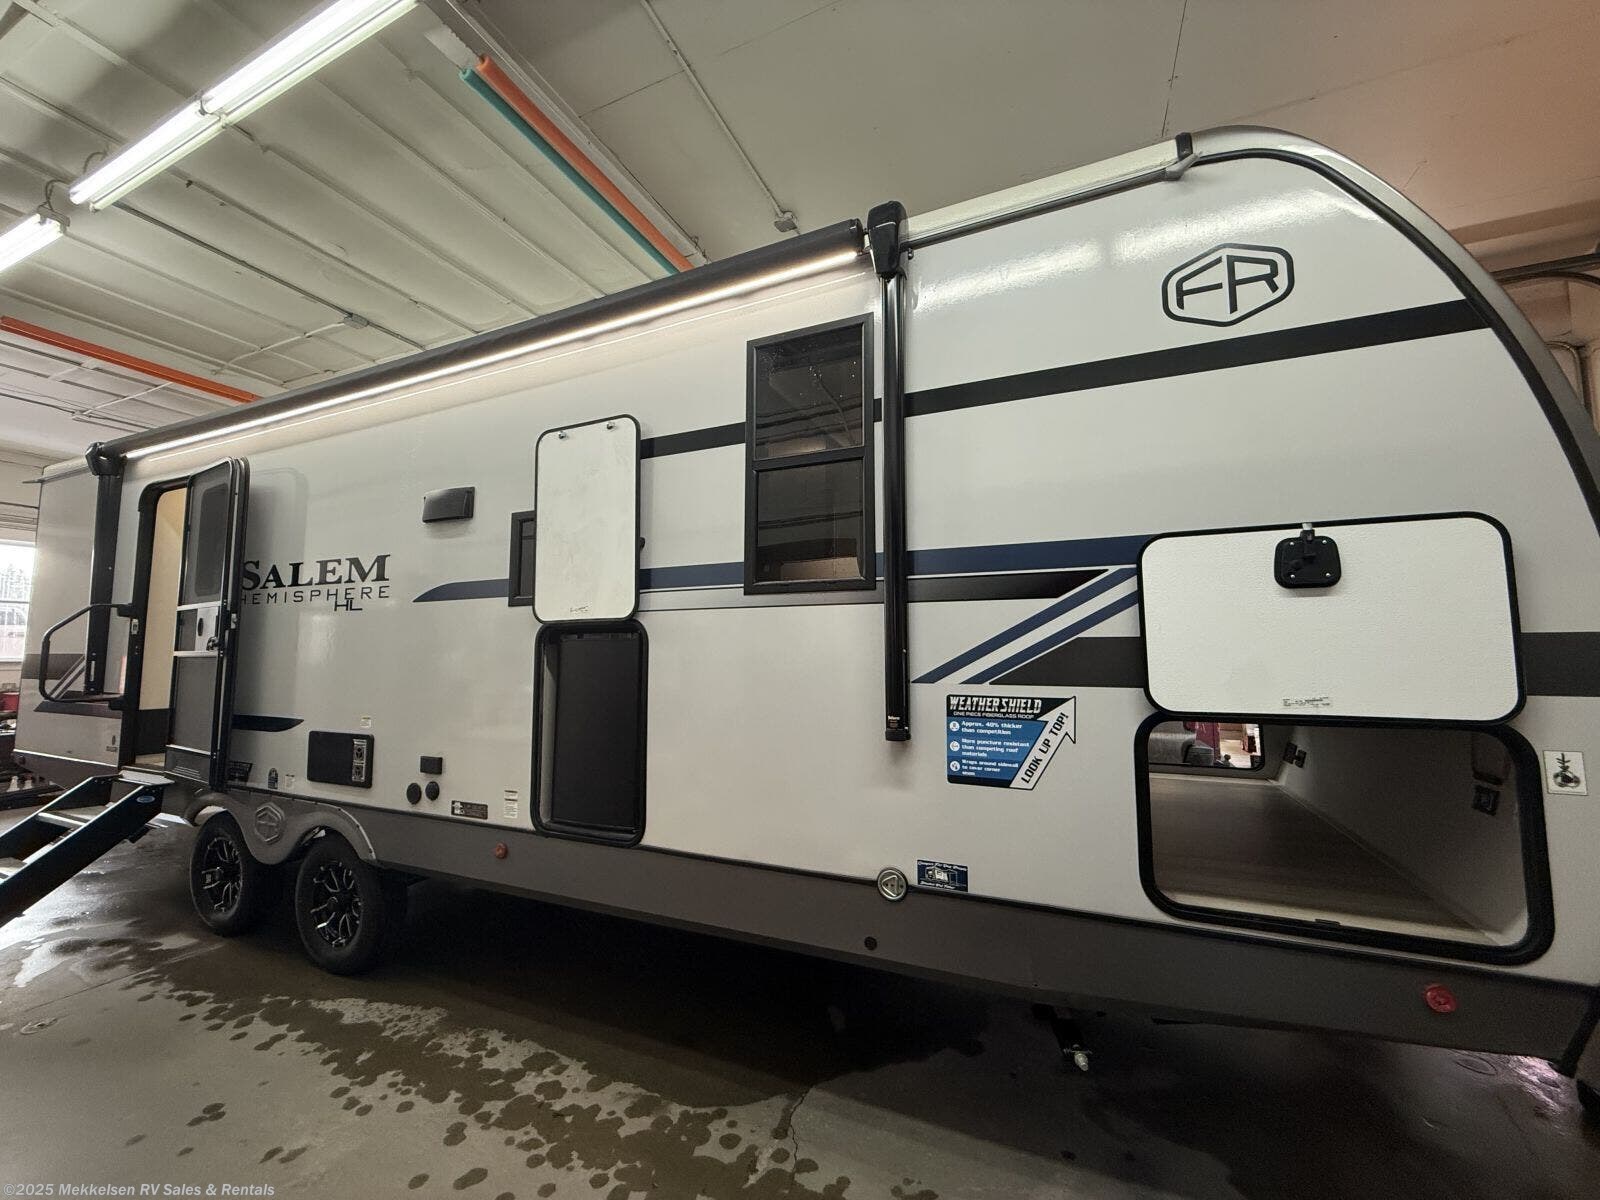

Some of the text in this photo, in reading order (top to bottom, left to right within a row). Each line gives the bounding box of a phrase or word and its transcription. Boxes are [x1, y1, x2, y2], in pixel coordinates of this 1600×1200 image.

[242, 554, 391, 590] SALEM
[334, 600, 363, 611] HL
[949, 696, 1042, 714] WEATHER SHIELD
[961, 720, 984, 728] Approx.
[1021, 712, 1069, 784] LOOK UP TOP!
